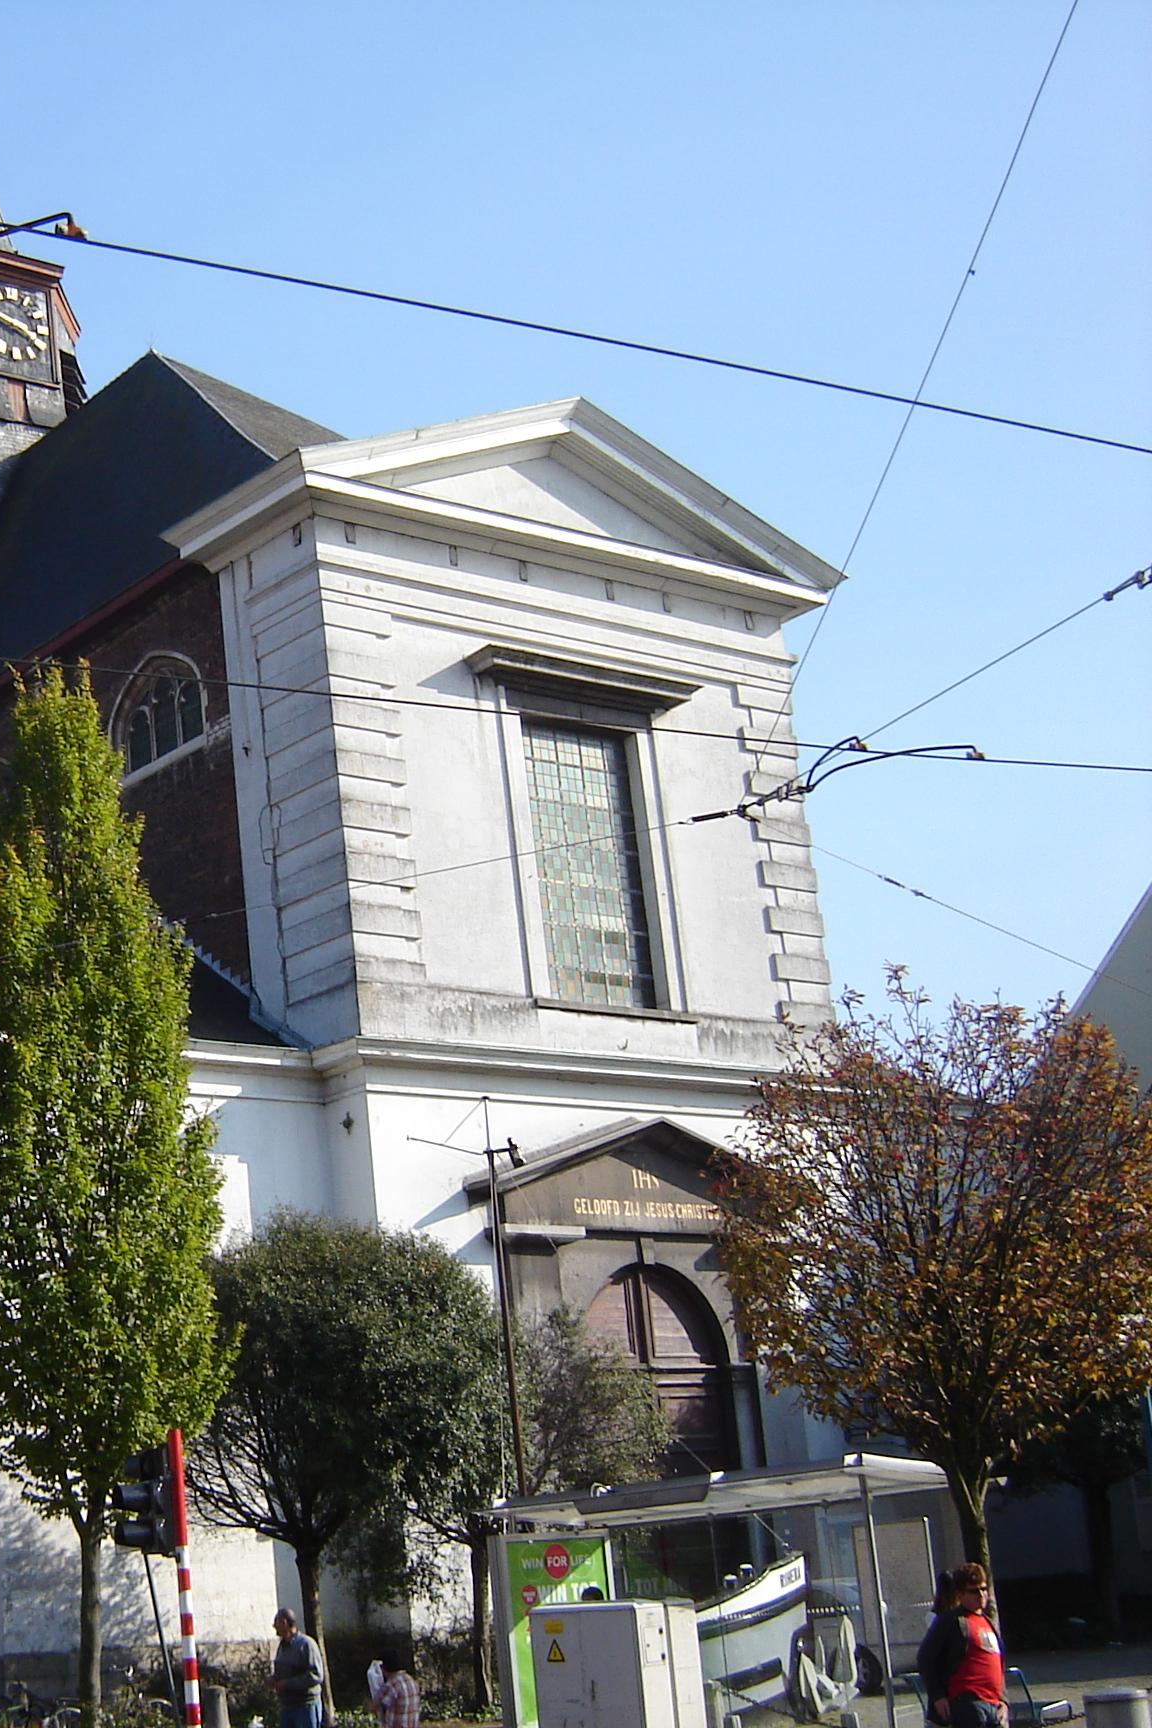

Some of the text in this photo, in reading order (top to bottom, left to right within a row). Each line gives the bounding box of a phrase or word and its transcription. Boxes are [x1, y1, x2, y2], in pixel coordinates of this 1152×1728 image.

[573, 1197, 721, 1221] GELOOFD ZIJ JESUS CHRISTUS
[521, 1557, 544, 1570] WIN
[546, 1555, 568, 1569] FOR
[537, 1583, 568, 1603] WIN
